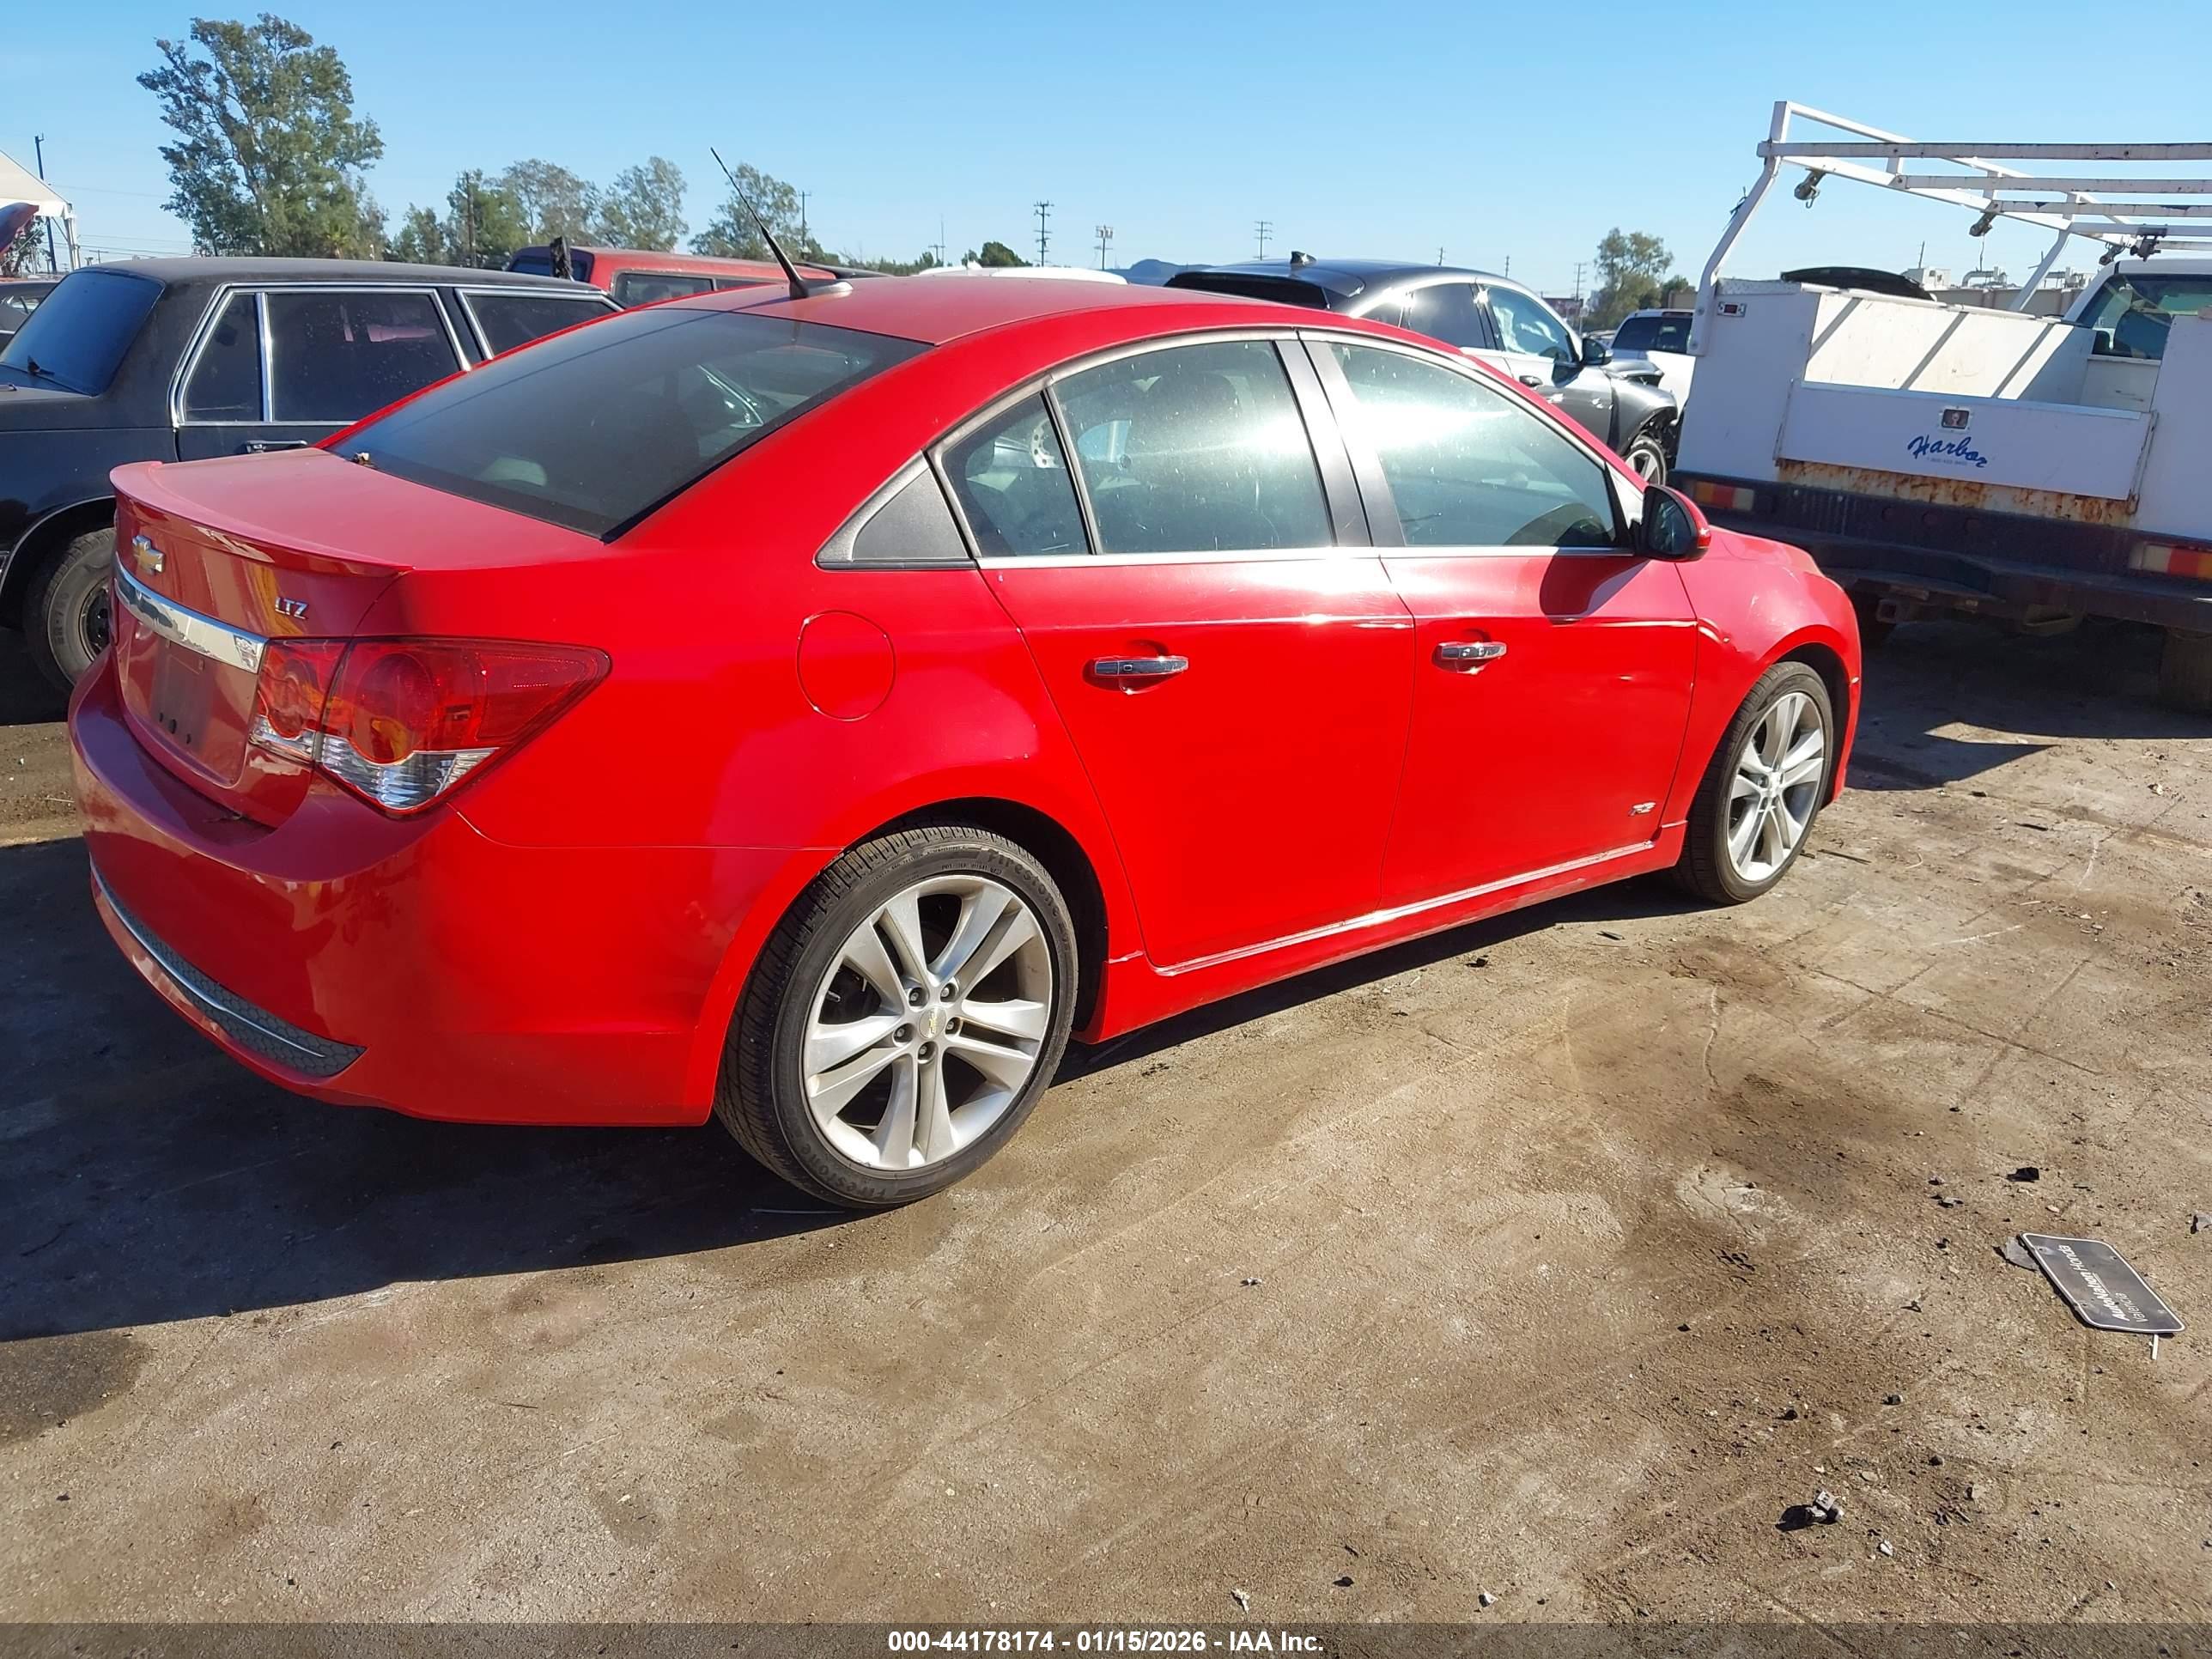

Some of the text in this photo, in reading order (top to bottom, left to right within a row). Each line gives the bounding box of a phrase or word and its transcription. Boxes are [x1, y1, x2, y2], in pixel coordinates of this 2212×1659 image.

[1907, 434, 1987, 468] Harbor
[275, 597, 307, 619] LTZ
[988, 848, 1060, 917] Firestone
[2058, 1244, 2130, 1322] AutoNation Honda
[2115, 1292, 2148, 1322] Valencia
